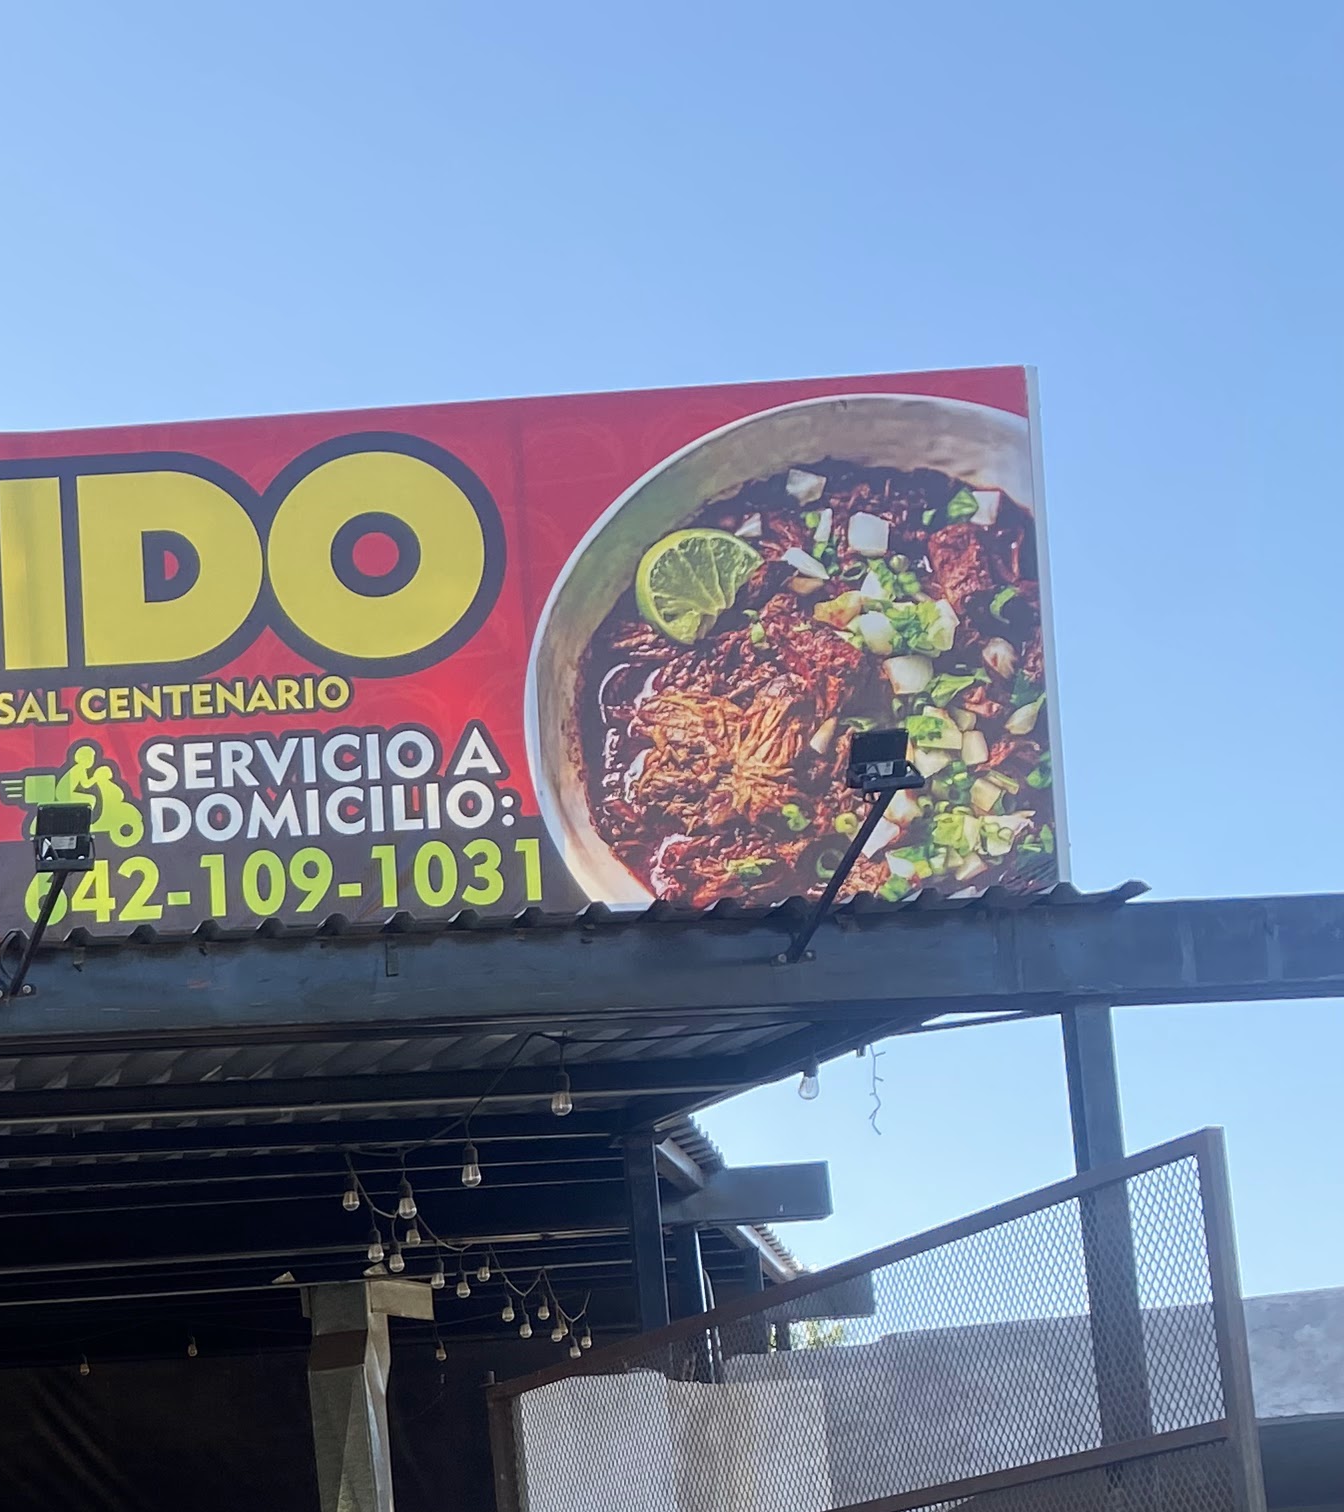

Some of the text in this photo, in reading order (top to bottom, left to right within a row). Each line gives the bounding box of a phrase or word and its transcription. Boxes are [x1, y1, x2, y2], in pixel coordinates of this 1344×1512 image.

[78, 676, 351, 722] CENTENARIO
[145, 725, 502, 792] SERVICIO A
[147, 780, 515, 844] DOMICILIO:
